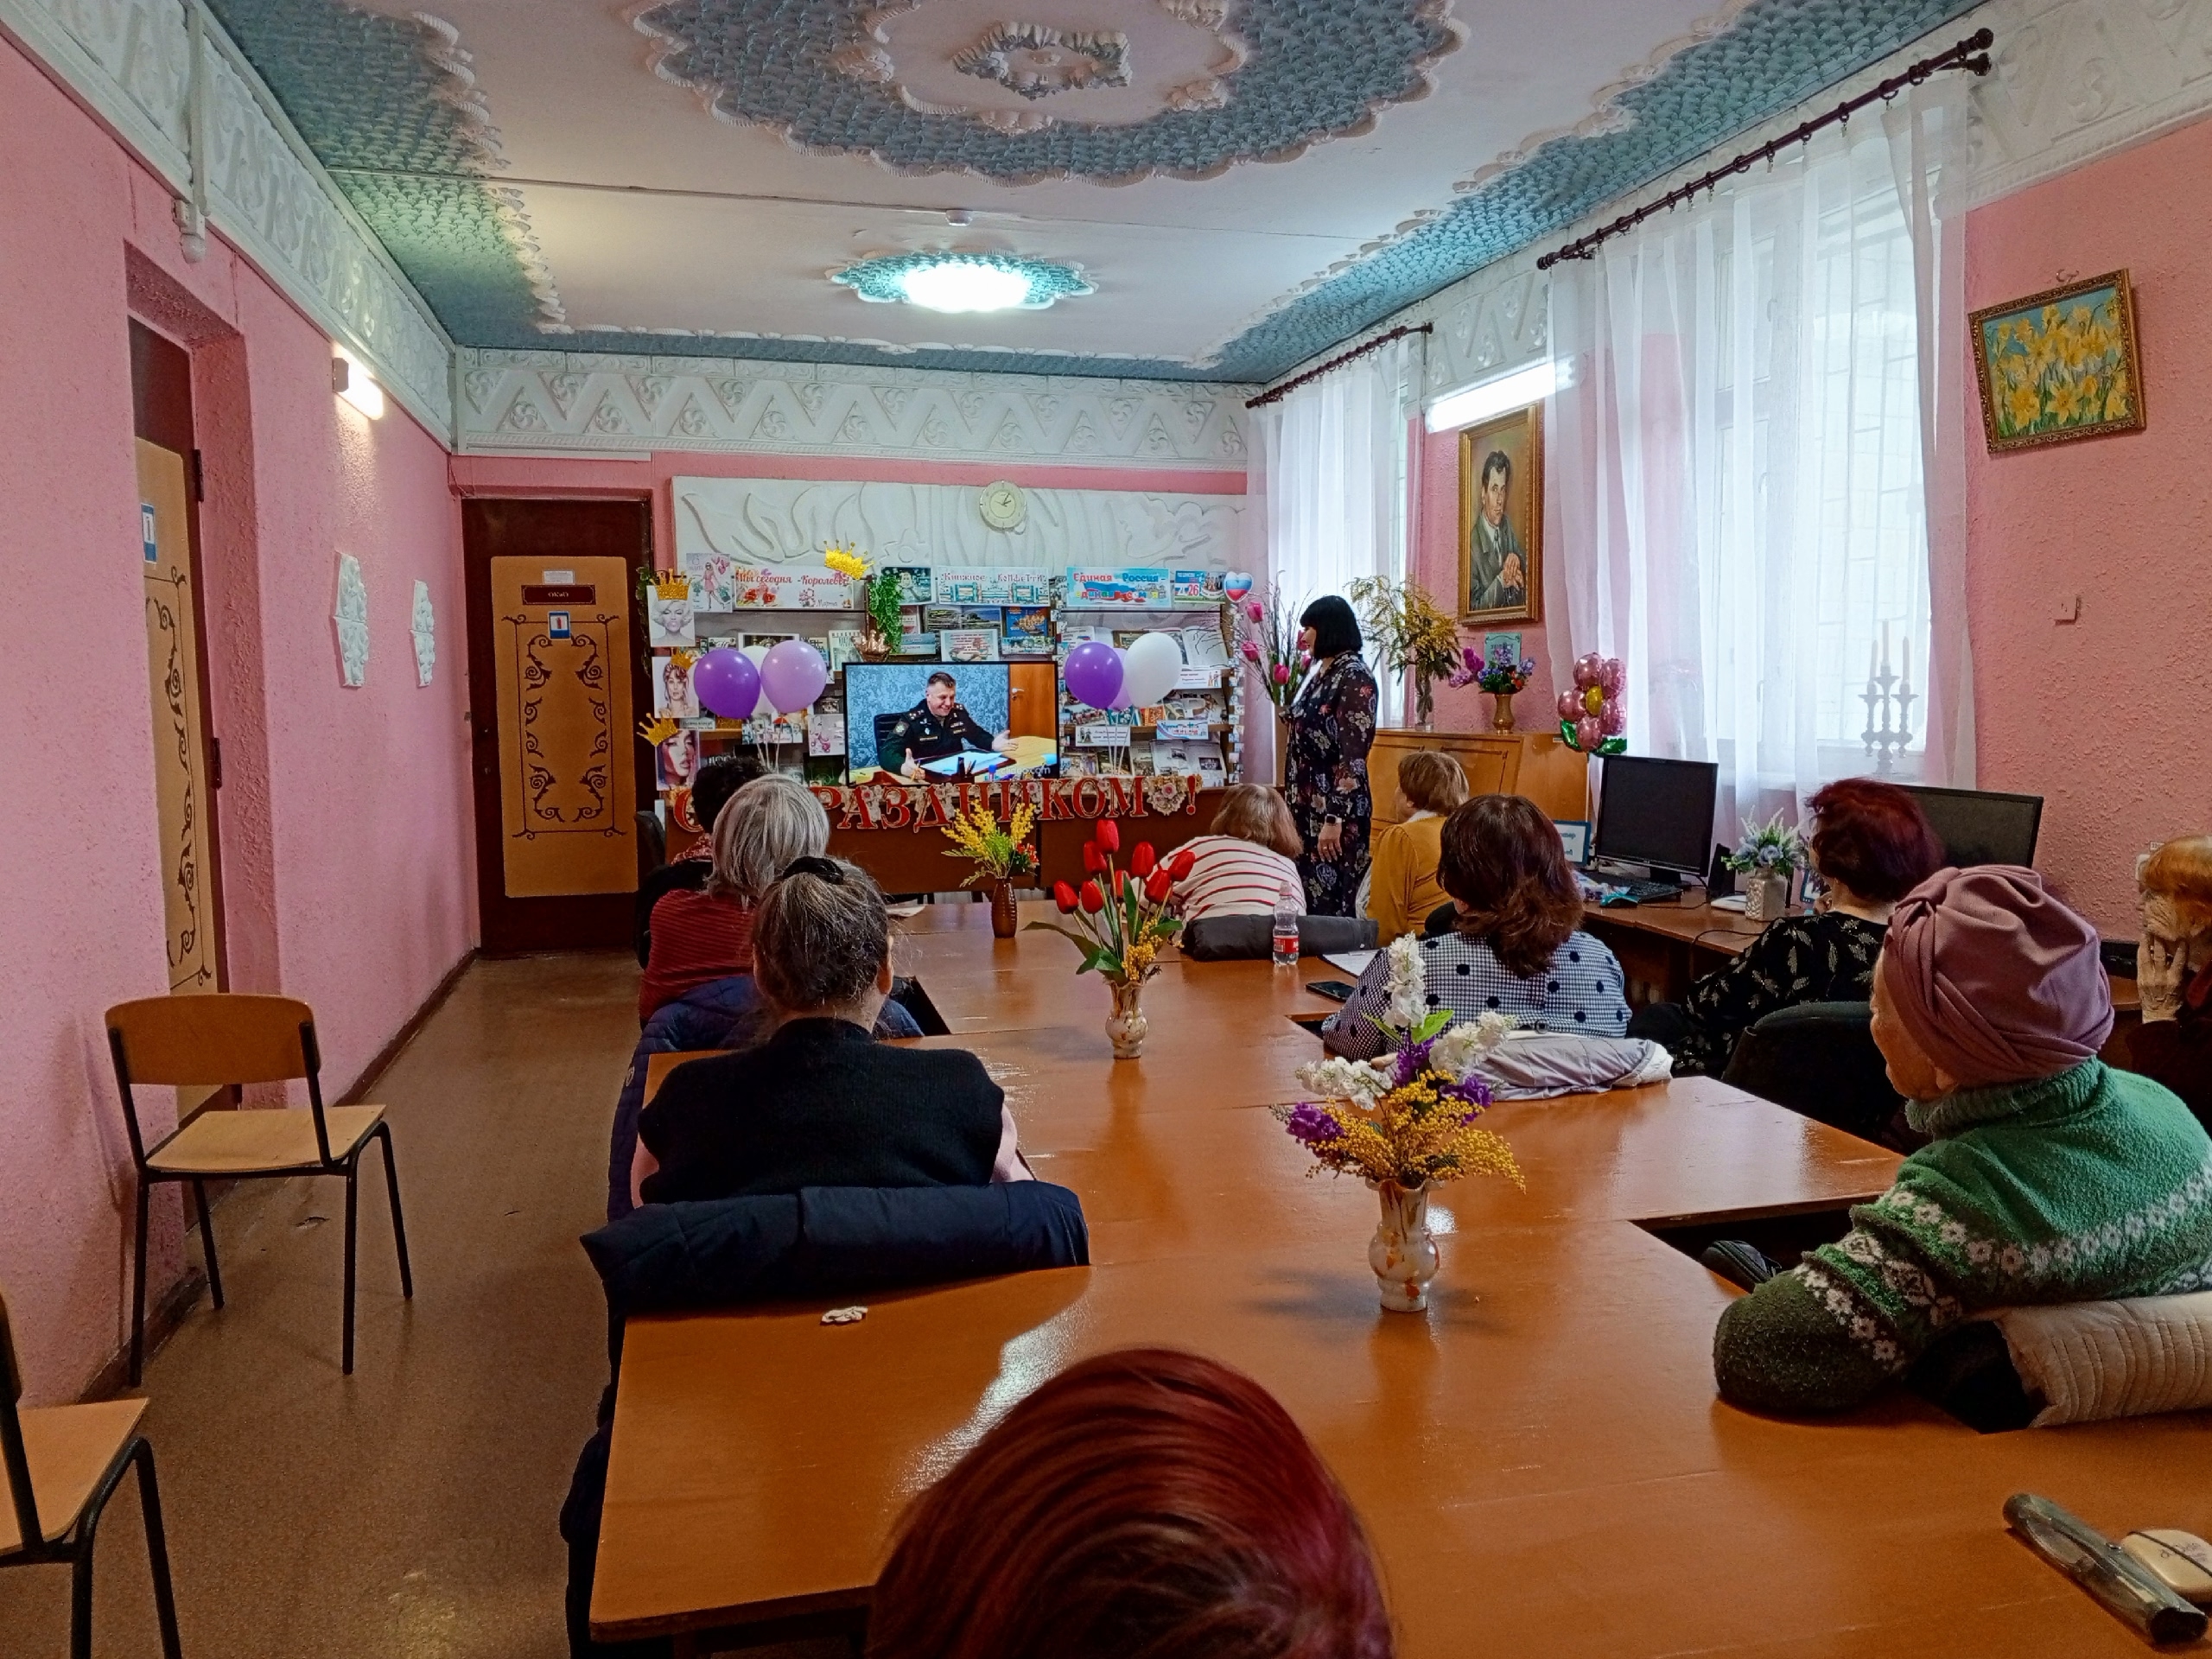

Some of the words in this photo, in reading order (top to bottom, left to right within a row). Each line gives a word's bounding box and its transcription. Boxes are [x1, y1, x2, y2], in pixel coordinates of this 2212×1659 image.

[755, 574, 792, 585] сегодня
[1073, 573, 1112, 582] Единая
[1122, 573, 1159, 582] Россия
[808, 775, 1149, 833] РАЗДНИКОМ
